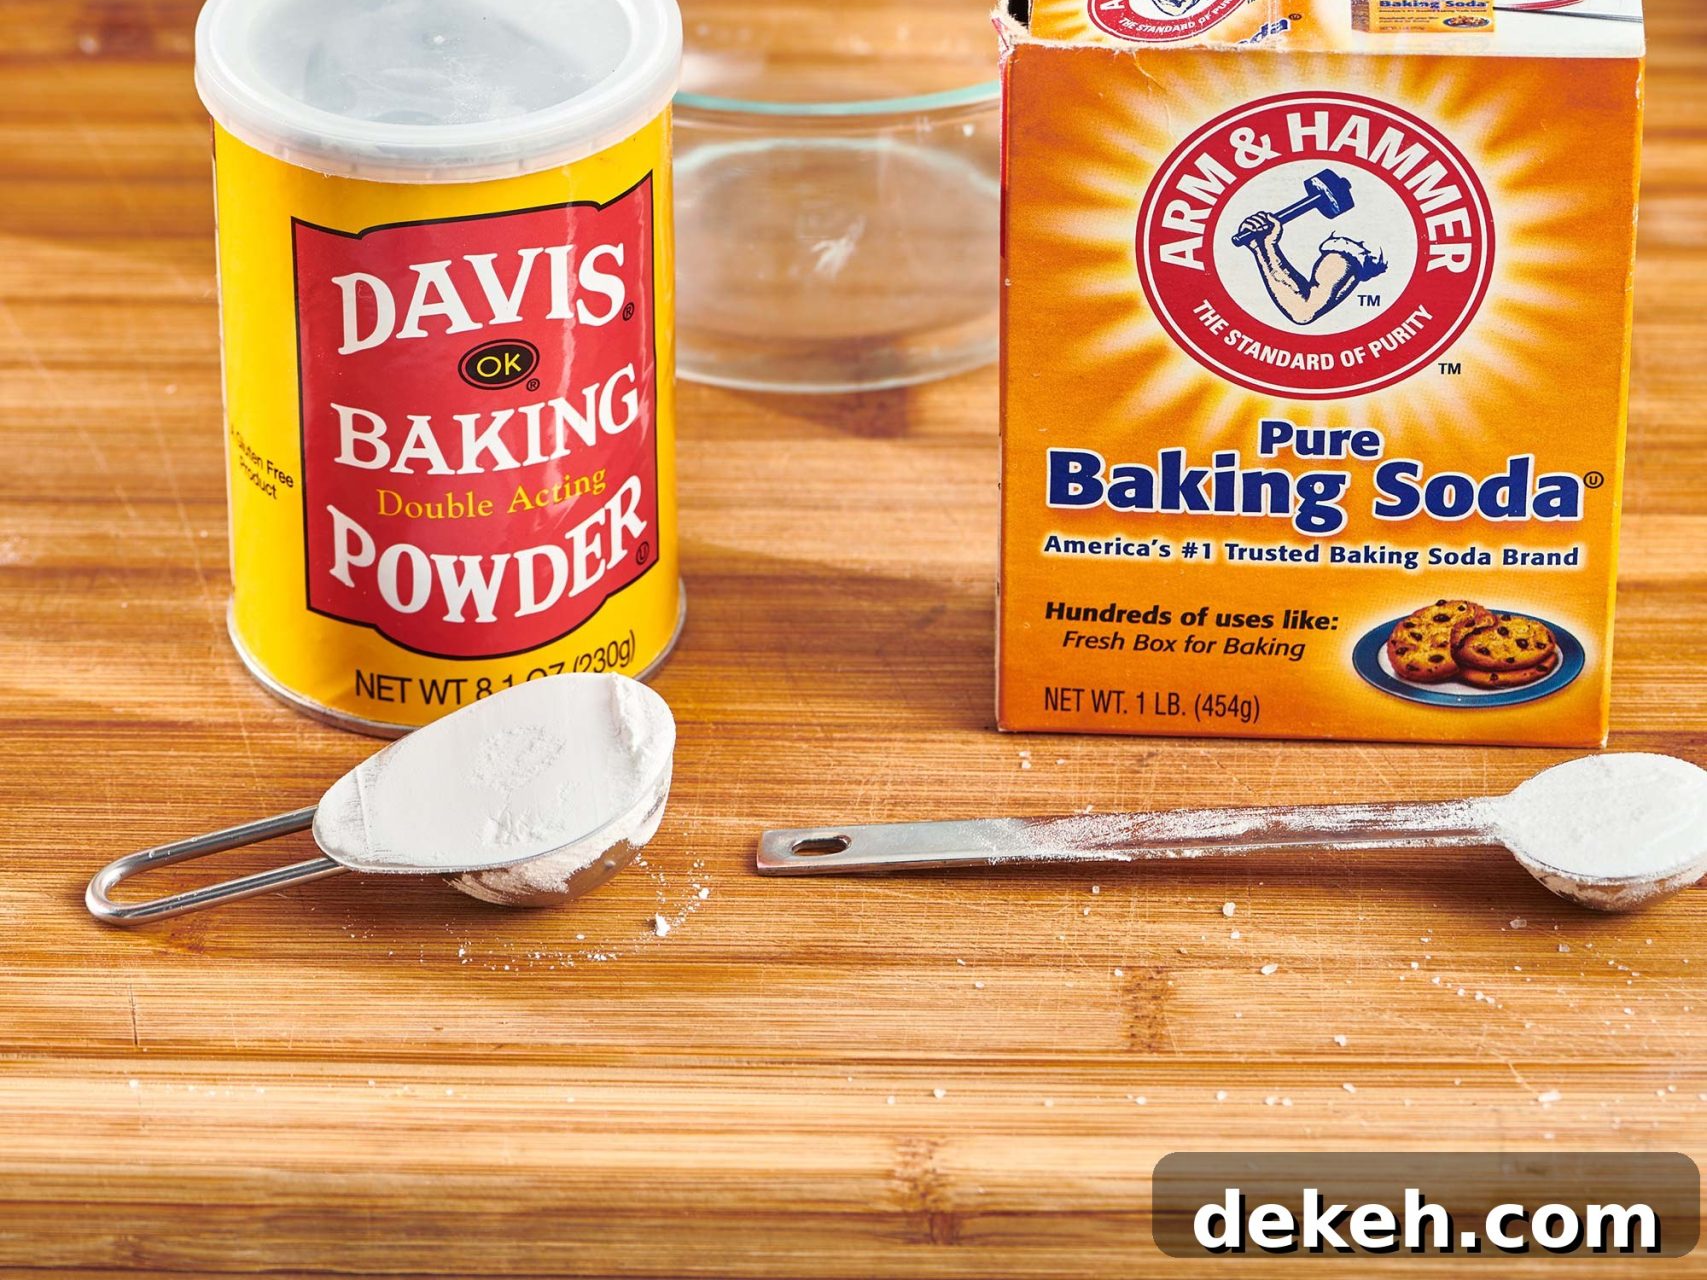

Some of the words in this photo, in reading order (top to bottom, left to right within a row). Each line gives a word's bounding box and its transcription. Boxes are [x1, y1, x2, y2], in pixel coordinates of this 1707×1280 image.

[1118, 16, 1136, 31] THE
[1135, 20, 1196, 34] STANDARD
[1198, 10, 1212, 26] OF
[1159, 151, 1238, 272] ARM
[1229, 126, 1283, 169] &
[1286, 110, 1473, 274] HAMMER
[331, 242, 626, 355] DAVIS
[1192, 298, 1220, 336] THE
[1223, 328, 1335, 371] STANDARD
[1341, 346, 1367, 368] OF
[1372, 304, 1434, 358] PURITY
[476, 352, 522, 378] OK
[330, 363, 639, 475] BAKING
[1260, 421, 1381, 460] Pure
[266, 459, 294, 489] Free
[1047, 450, 1346, 534] Baking
[1373, 455, 1582, 519] Soda
[376, 488, 494, 520] Double
[506, 468, 608, 515] Acting
[326, 475, 647, 623] POWDER
[1044, 535, 1171, 558] America's
[1181, 542, 1212, 559] #1
[1224, 543, 1319, 562] Trusted
[1330, 545, 1419, 570] Baking
[1428, 547, 1492, 566] Soda
[1502, 547, 1579, 566] Brand
[1045, 601, 1172, 625] Hundreds
[1180, 606, 1210, 627] of
[1215, 613, 1274, 629] uses
[1282, 609, 1339, 630] like:
[1062, 630, 1125, 650] Fresh
[1133, 634, 1177, 652] Box
[1184, 635, 1217, 654] for
[1223, 637, 1306, 662] Baking
[355, 669, 412, 704] NET
[419, 677, 468, 705] WT
[1044, 687, 1085, 712] NET
[1091, 690, 1128, 714] WT.
[1136, 691, 1145, 715] 1
[1154, 692, 1186, 716] LB.
[1194, 693, 1260, 723] (454g)
